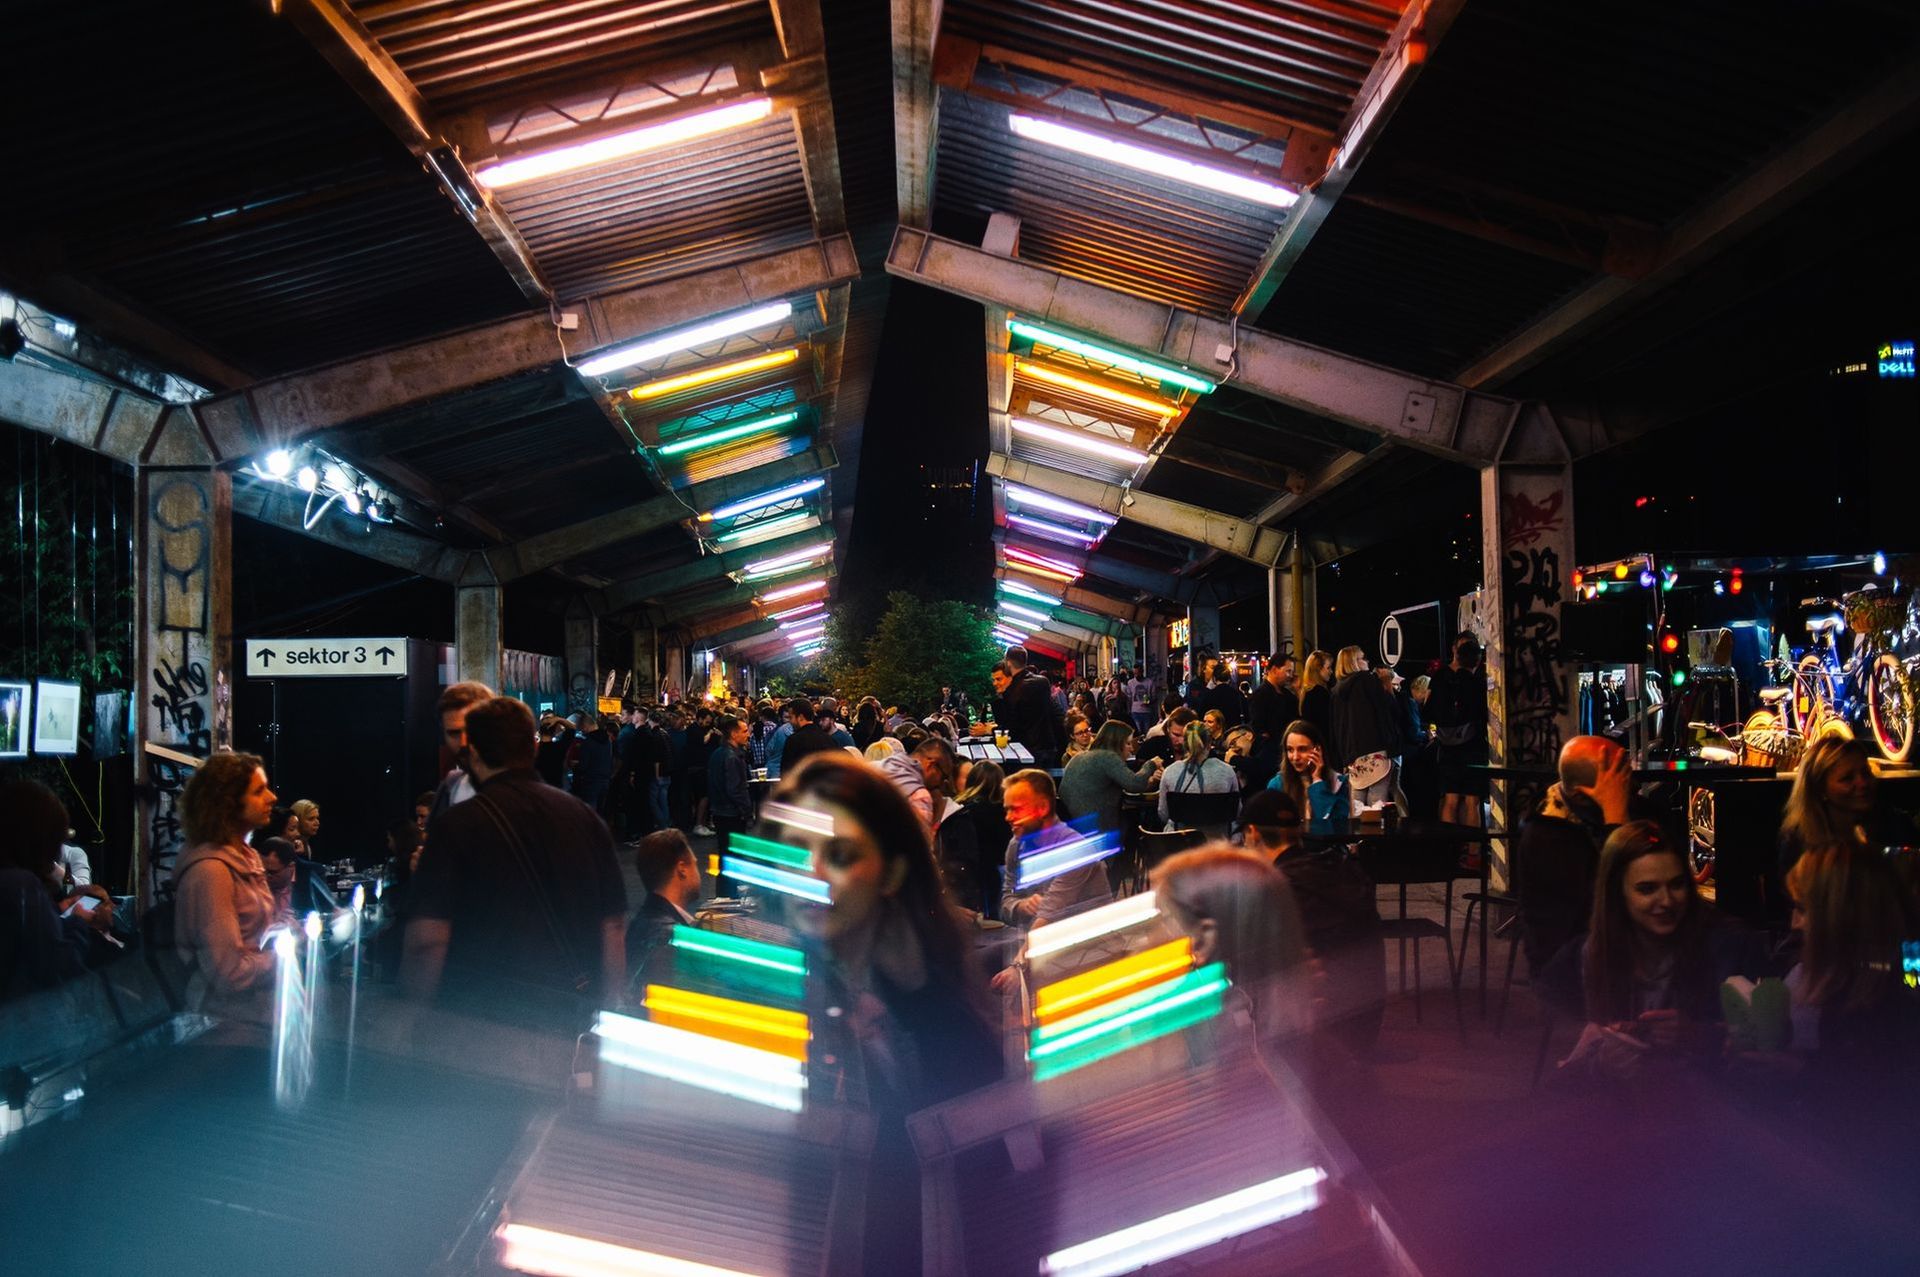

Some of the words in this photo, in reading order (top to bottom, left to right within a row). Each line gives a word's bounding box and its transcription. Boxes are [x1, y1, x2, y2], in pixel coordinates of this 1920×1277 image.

[1878, 362, 1916, 374] DELL
[286, 647, 350, 665] sektor
[354, 646, 367, 664] 3
